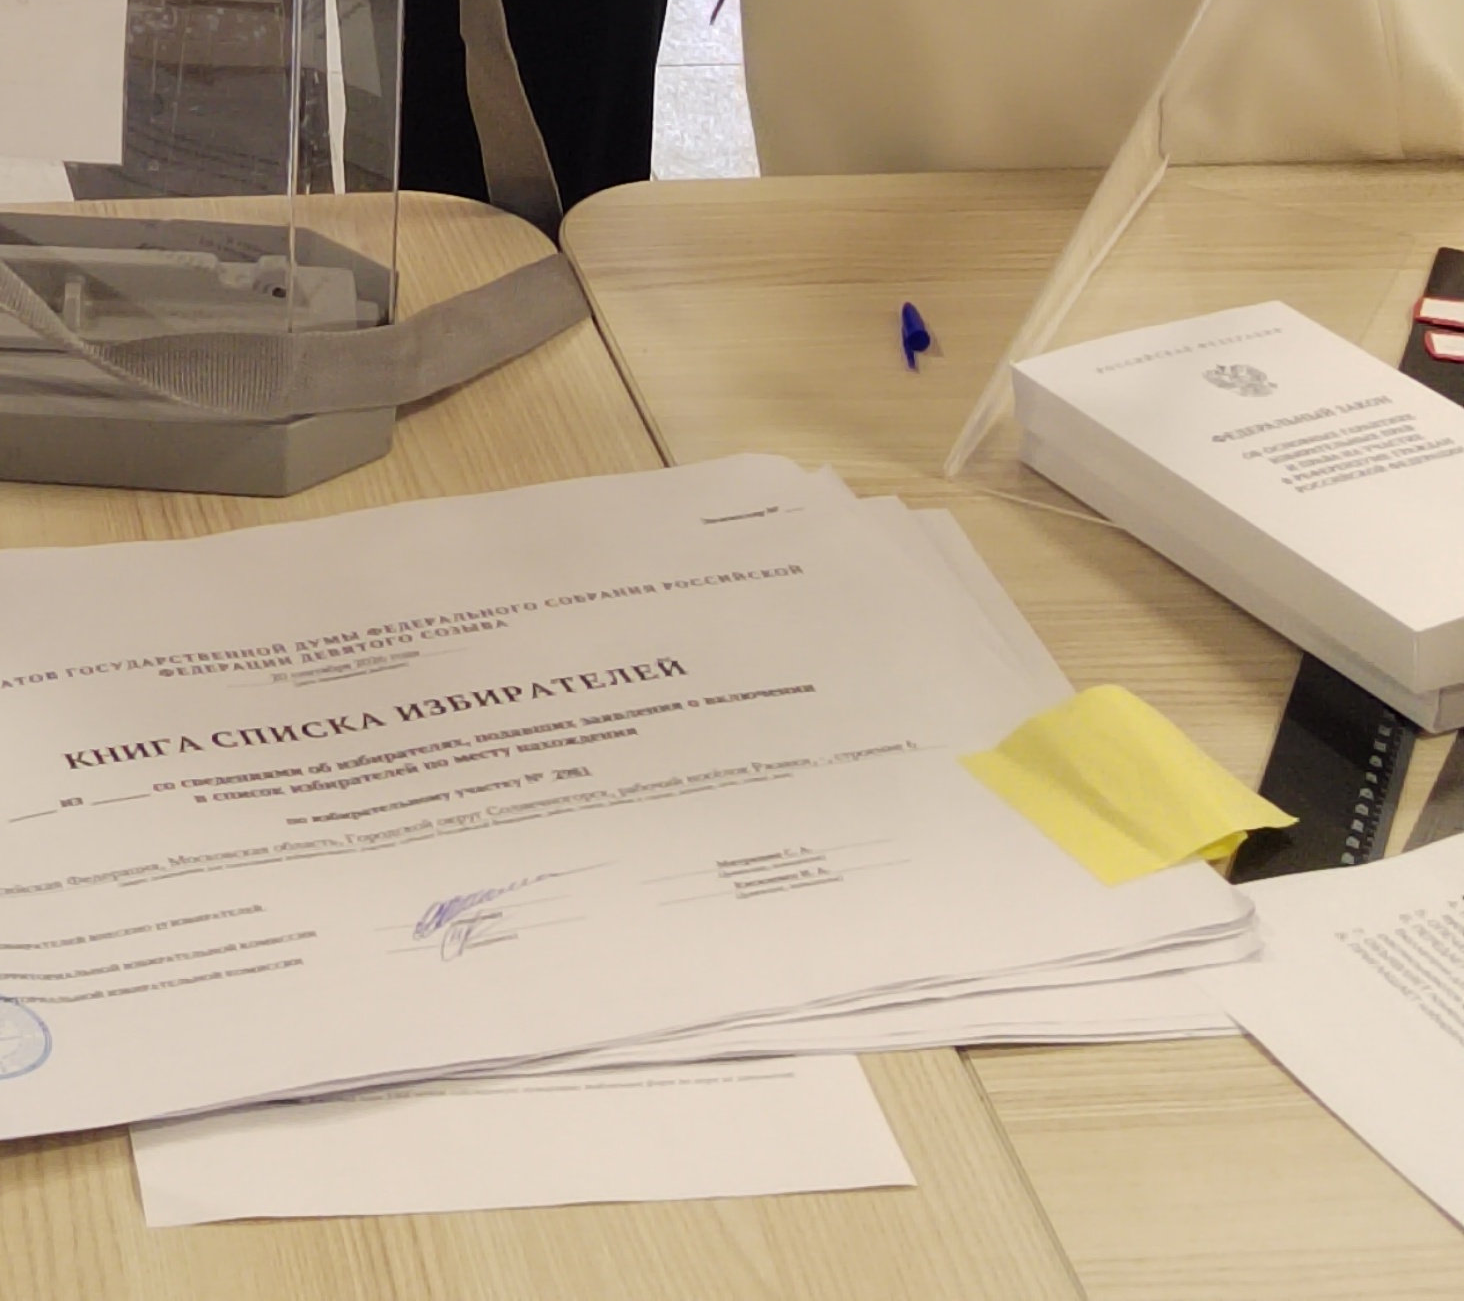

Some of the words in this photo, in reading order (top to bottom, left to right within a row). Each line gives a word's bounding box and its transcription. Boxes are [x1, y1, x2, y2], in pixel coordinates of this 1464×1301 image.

[65, 643, 288, 678] ГОСУДАРСТВЕННОЙ
[294, 631, 360, 652] ДУМЫ
[366, 601, 538, 637] ФЕДЕРАЛЬНОГО
[544, 582, 657, 609] СОБРАНИЯ
[661, 564, 804, 591] РОССИЙСКОЙ
[158, 654, 293, 678] ФЕДЕРАЦИИ
[301, 633, 414, 664] ДЕВЯТОГО
[420, 619, 510, 639] СОЗЫВА
[62, 736, 205, 770] КНИГА
[211, 712, 388, 749] СПИСКА
[393, 656, 690, 722] ИЗБИРАТЕЛЕЙ
[153, 781, 177, 792] со
[181, 767, 305, 789] сведениями
[308, 761, 332, 775] об
[336, 735, 471, 772] избирателях,
[475, 719, 577, 745] подавших
[580, 701, 684, 727] заявления
[686, 699, 701, 708] о
[194, 795, 208, 804] в
[212, 786, 285, 803] список
[289, 761, 420, 796] избирателей
[423, 758, 449, 770] по
[453, 746, 511, 766] месту
[515, 728, 639, 754] нахождения
[311, 791, 451, 824] избирательному
[454, 777, 522, 799] участку
